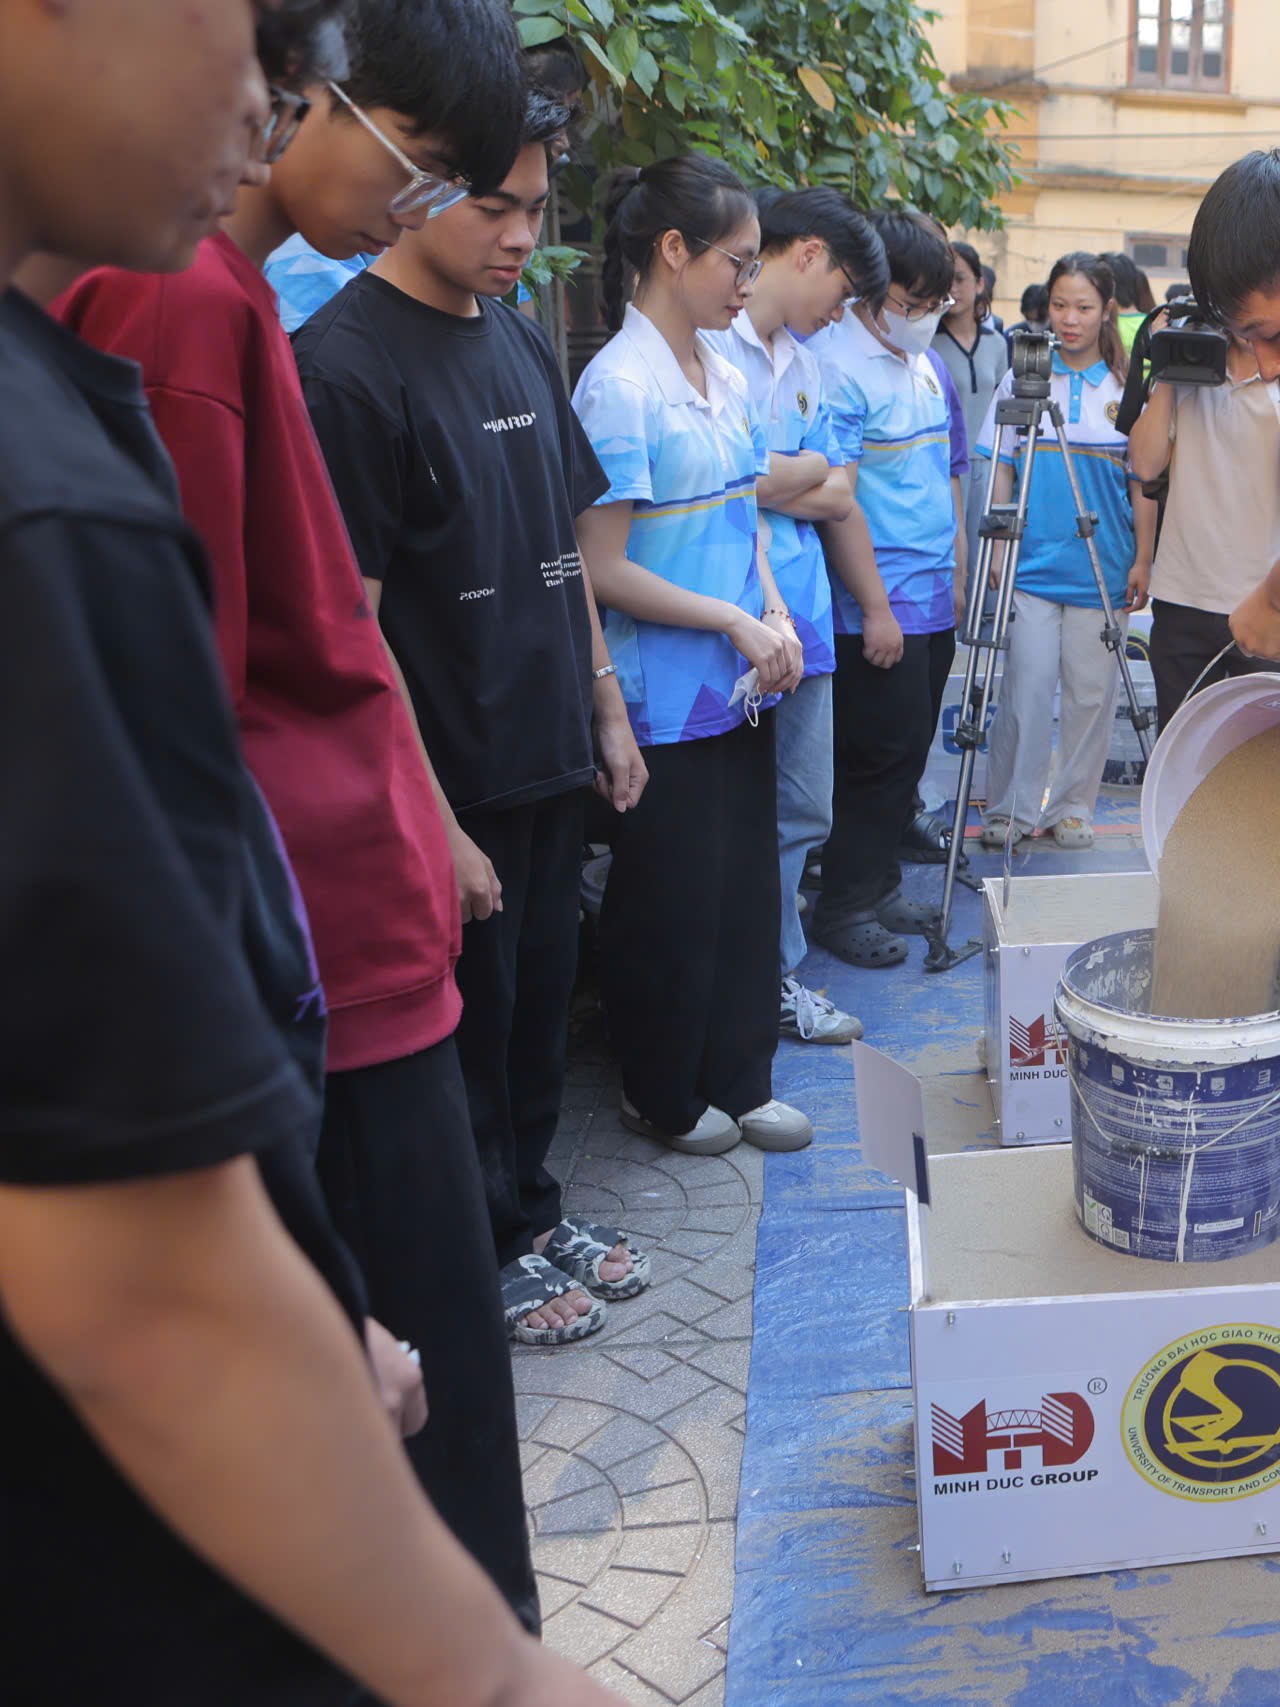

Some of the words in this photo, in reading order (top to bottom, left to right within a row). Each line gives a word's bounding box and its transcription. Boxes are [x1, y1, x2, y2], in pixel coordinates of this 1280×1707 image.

[1009, 1071, 1040, 1081] MINH
[1043, 1069, 1069, 1079] DUC
[1221, 1329, 1253, 1339] GIAO
[1128, 1426, 1159, 1477] UNIVERSITY
[1157, 1472, 1173, 1485] OF
[1172, 1480, 1236, 1497] TRANSPORT
[1237, 1479, 1261, 1494] AND
[934, 1479, 980, 1496] MINH
[986, 1475, 1025, 1491] DUC
[1030, 1469, 1099, 1487] GROUP
